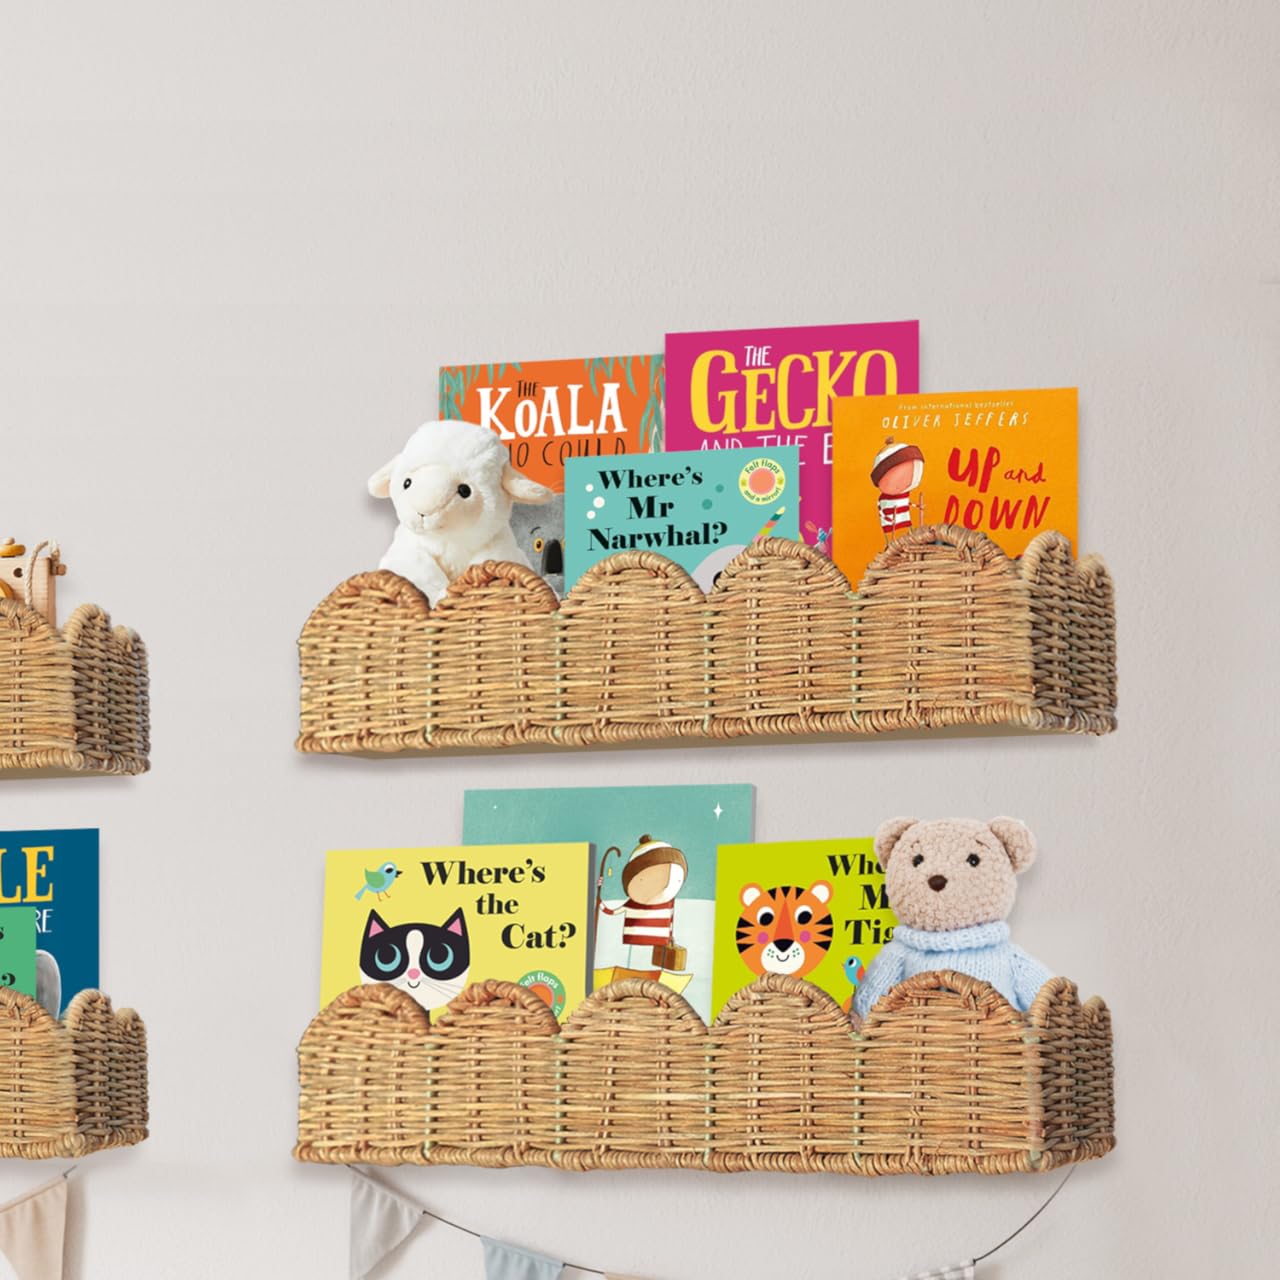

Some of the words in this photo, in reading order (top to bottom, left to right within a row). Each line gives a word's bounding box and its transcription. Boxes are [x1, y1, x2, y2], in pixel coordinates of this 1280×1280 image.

[743, 345, 772, 367] THE
[517, 380, 540, 398] THE
[690, 349, 898, 434] GECKO
[476, 382, 628, 440] KOALA
[882, 414, 941, 429] OLIVER
[954, 411, 1029, 428] JEFFERS
[598, 466, 703, 490] Where's
[947, 446, 1001, 493] UP
[1004, 461, 1046, 484] and
[626, 495, 675, 520] Mr
[943, 494, 1051, 531] DOWN
[587, 521, 728, 551] Narwhal?
[420, 858, 546, 885] Where's
[476, 893, 519, 915] the
[501, 922, 577, 950] Cat?
